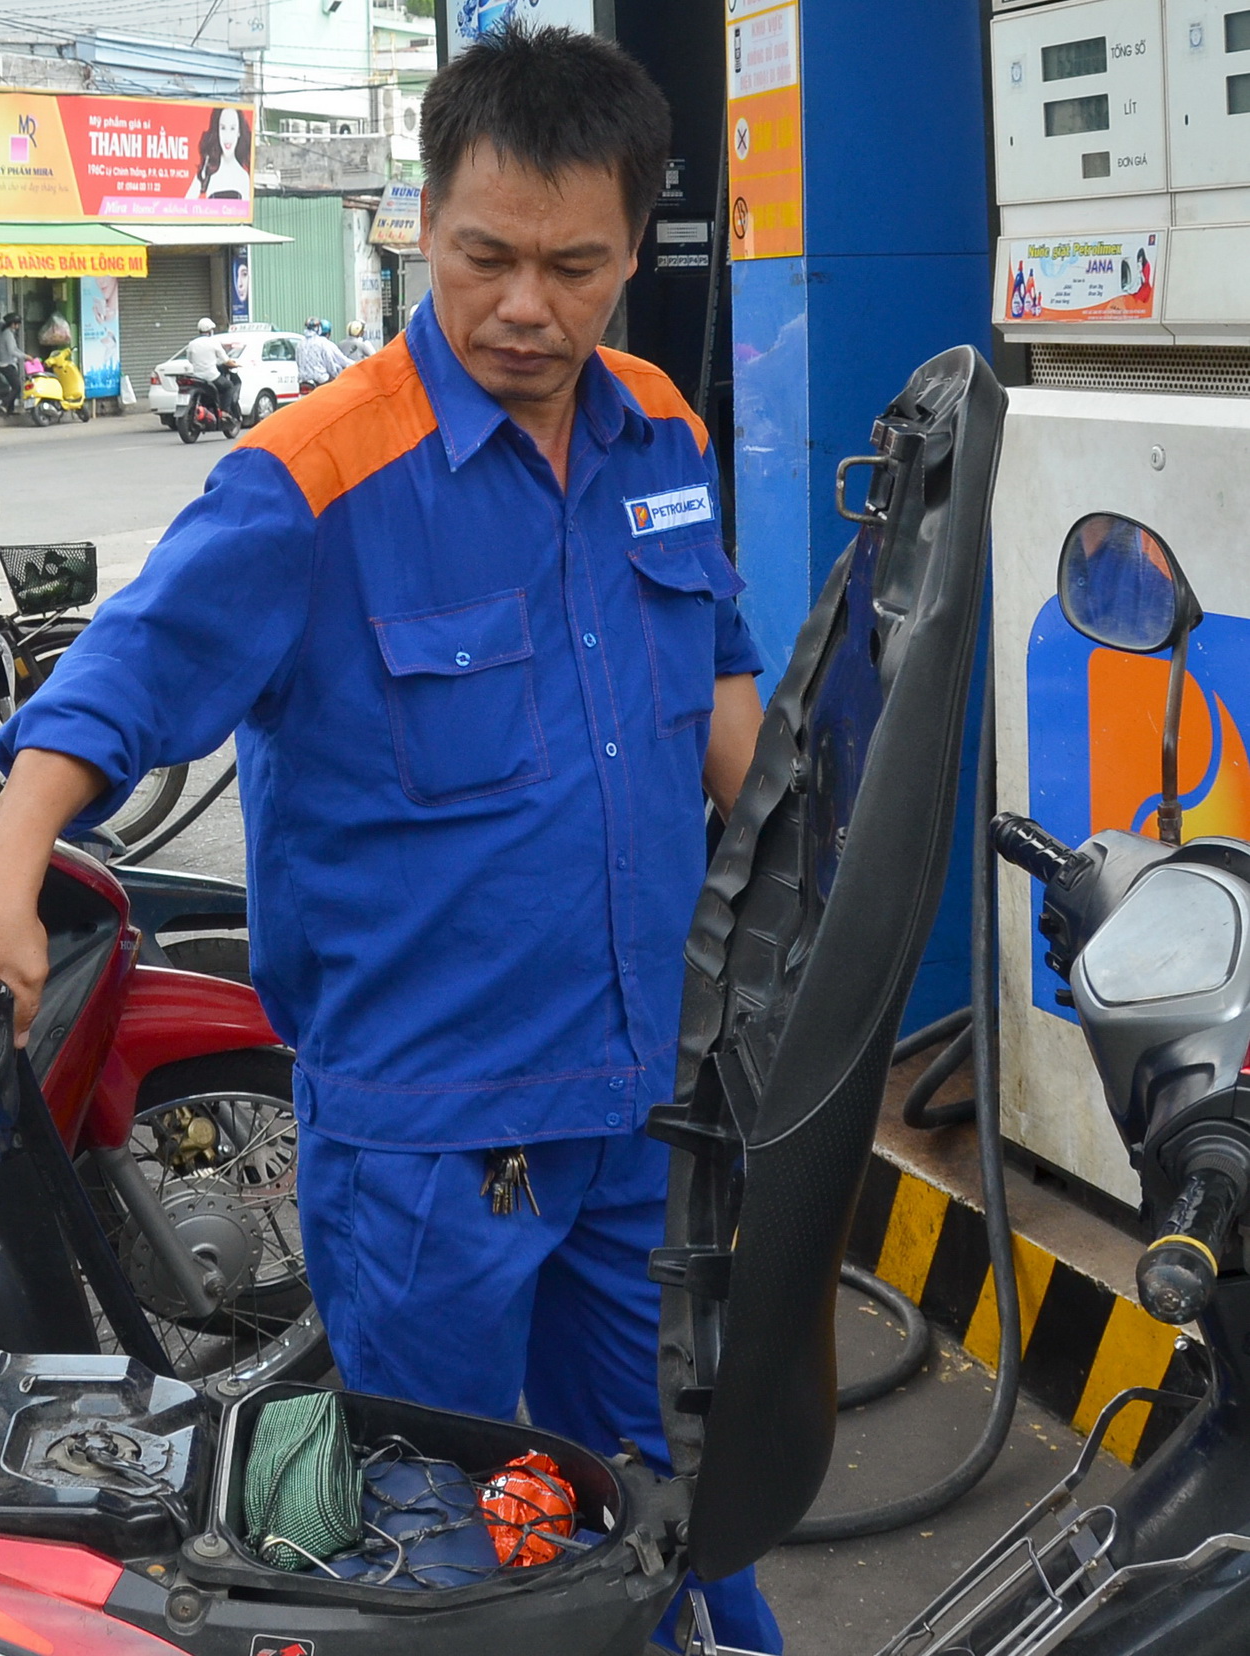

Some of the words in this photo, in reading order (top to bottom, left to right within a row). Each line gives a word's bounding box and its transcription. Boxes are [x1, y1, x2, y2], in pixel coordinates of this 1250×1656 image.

[1111, 43, 1133, 59] TỔNG
[1135, 39, 1147, 56] SỐ
[1124, 99, 1137, 116] LÍT
[88, 115, 101, 128] Mỹ
[88, 131, 142, 158] THANH
[147, 125, 189, 160] HẰNG
[1134, 153, 1147, 166] GIÁ
[33, 168, 53, 176] MIRA
[1073, 241, 1122, 257] Petrolimex
[59, 252, 87, 271] BÁN
[91, 252, 125, 271] LÔNG
[128, 256, 143, 271] MI
[1085, 258, 1114, 274] JANA
